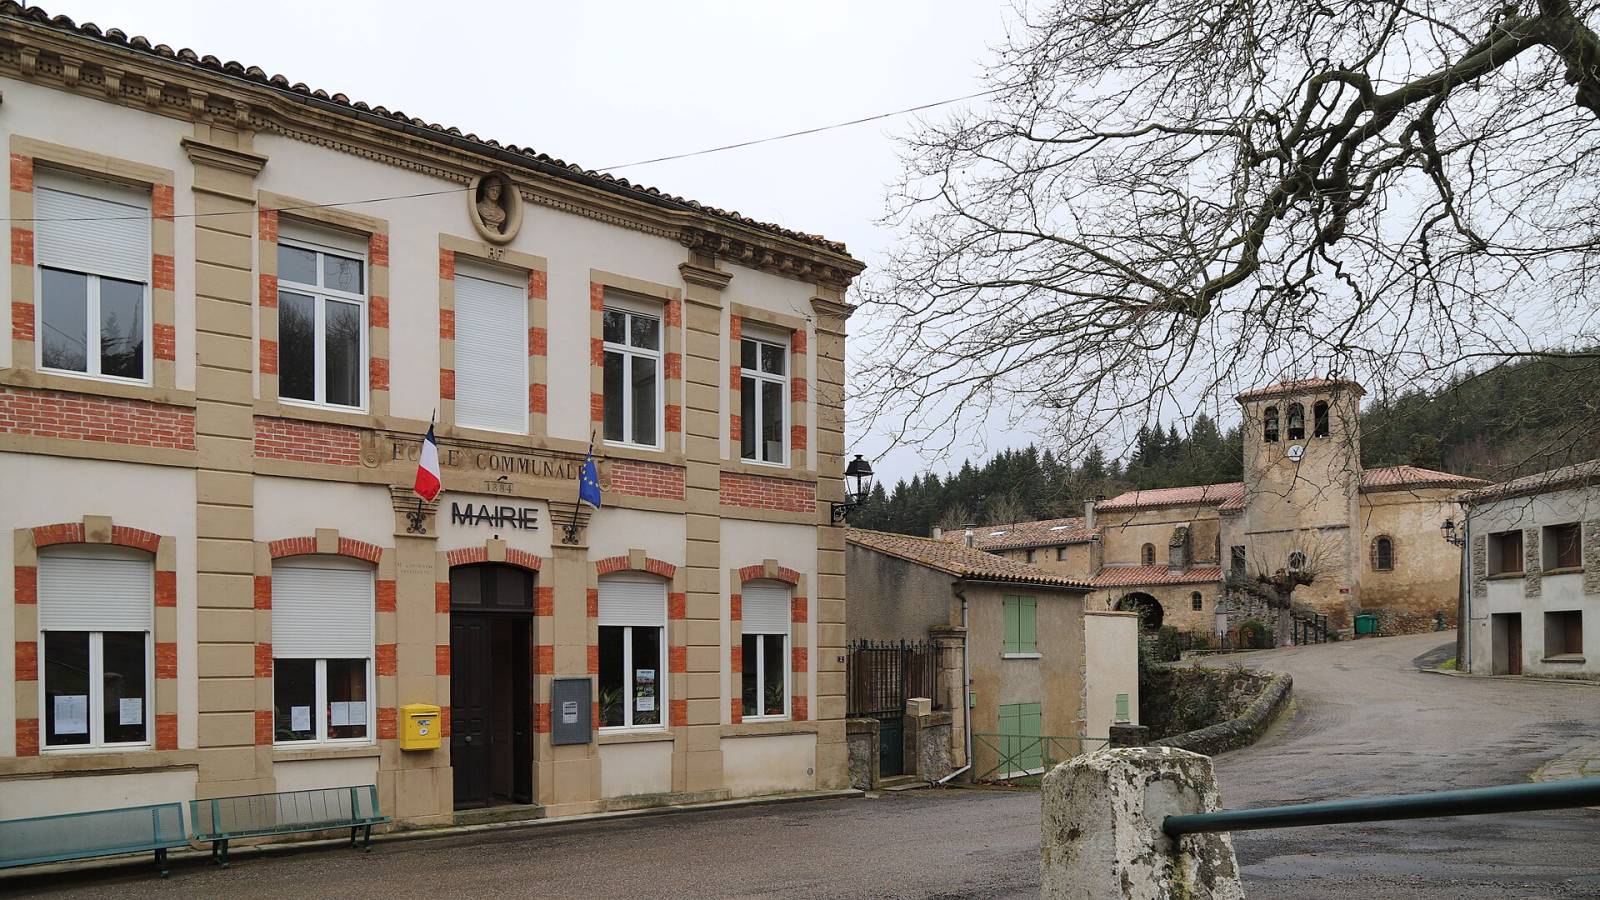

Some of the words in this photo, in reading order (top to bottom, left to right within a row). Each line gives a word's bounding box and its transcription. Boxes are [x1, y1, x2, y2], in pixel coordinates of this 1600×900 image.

[392, 443, 460, 467] ECE
[476, 452, 582, 480] COMMUNAL
[451, 502, 539, 530] MAIRIE
